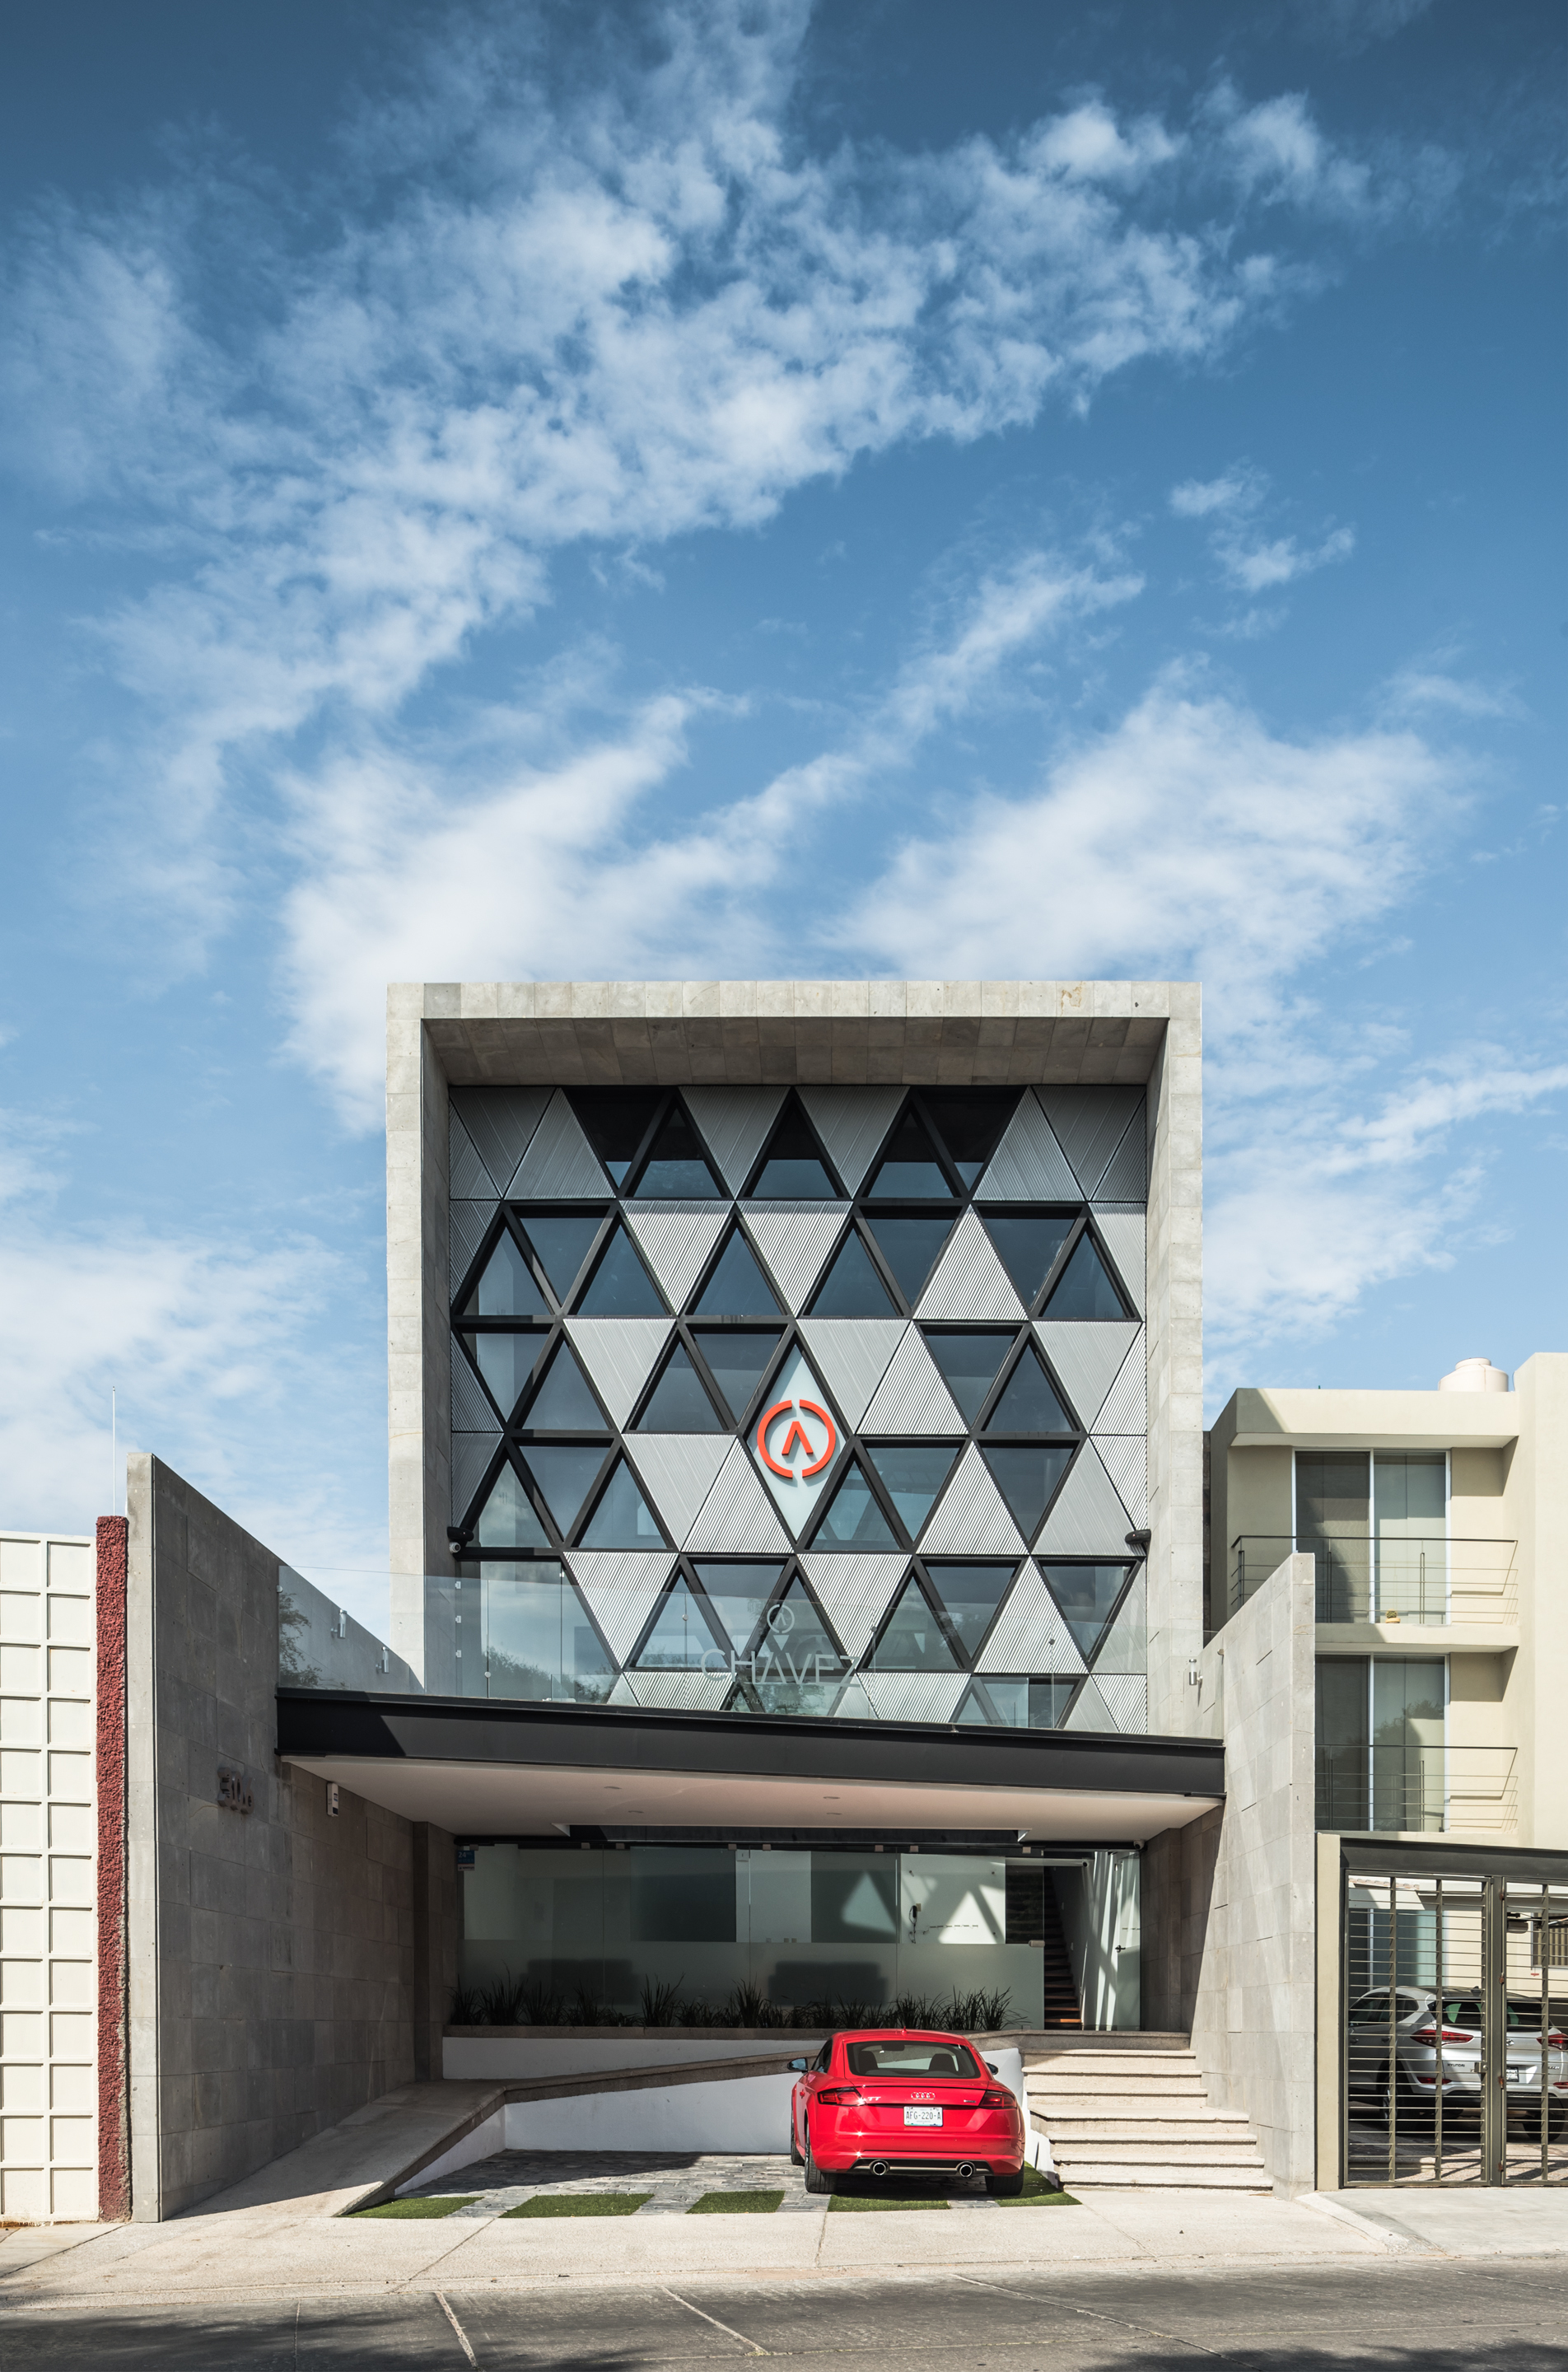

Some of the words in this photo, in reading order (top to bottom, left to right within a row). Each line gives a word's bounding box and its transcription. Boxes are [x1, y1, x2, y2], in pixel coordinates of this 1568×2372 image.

[701, 1649, 861, 1688] CHAVEZ
[726, 1696, 773, 1705] ABOGADOS
[217, 1767, 254, 1814] 306
[906, 2111, 941, 2120] AFG-220-A
